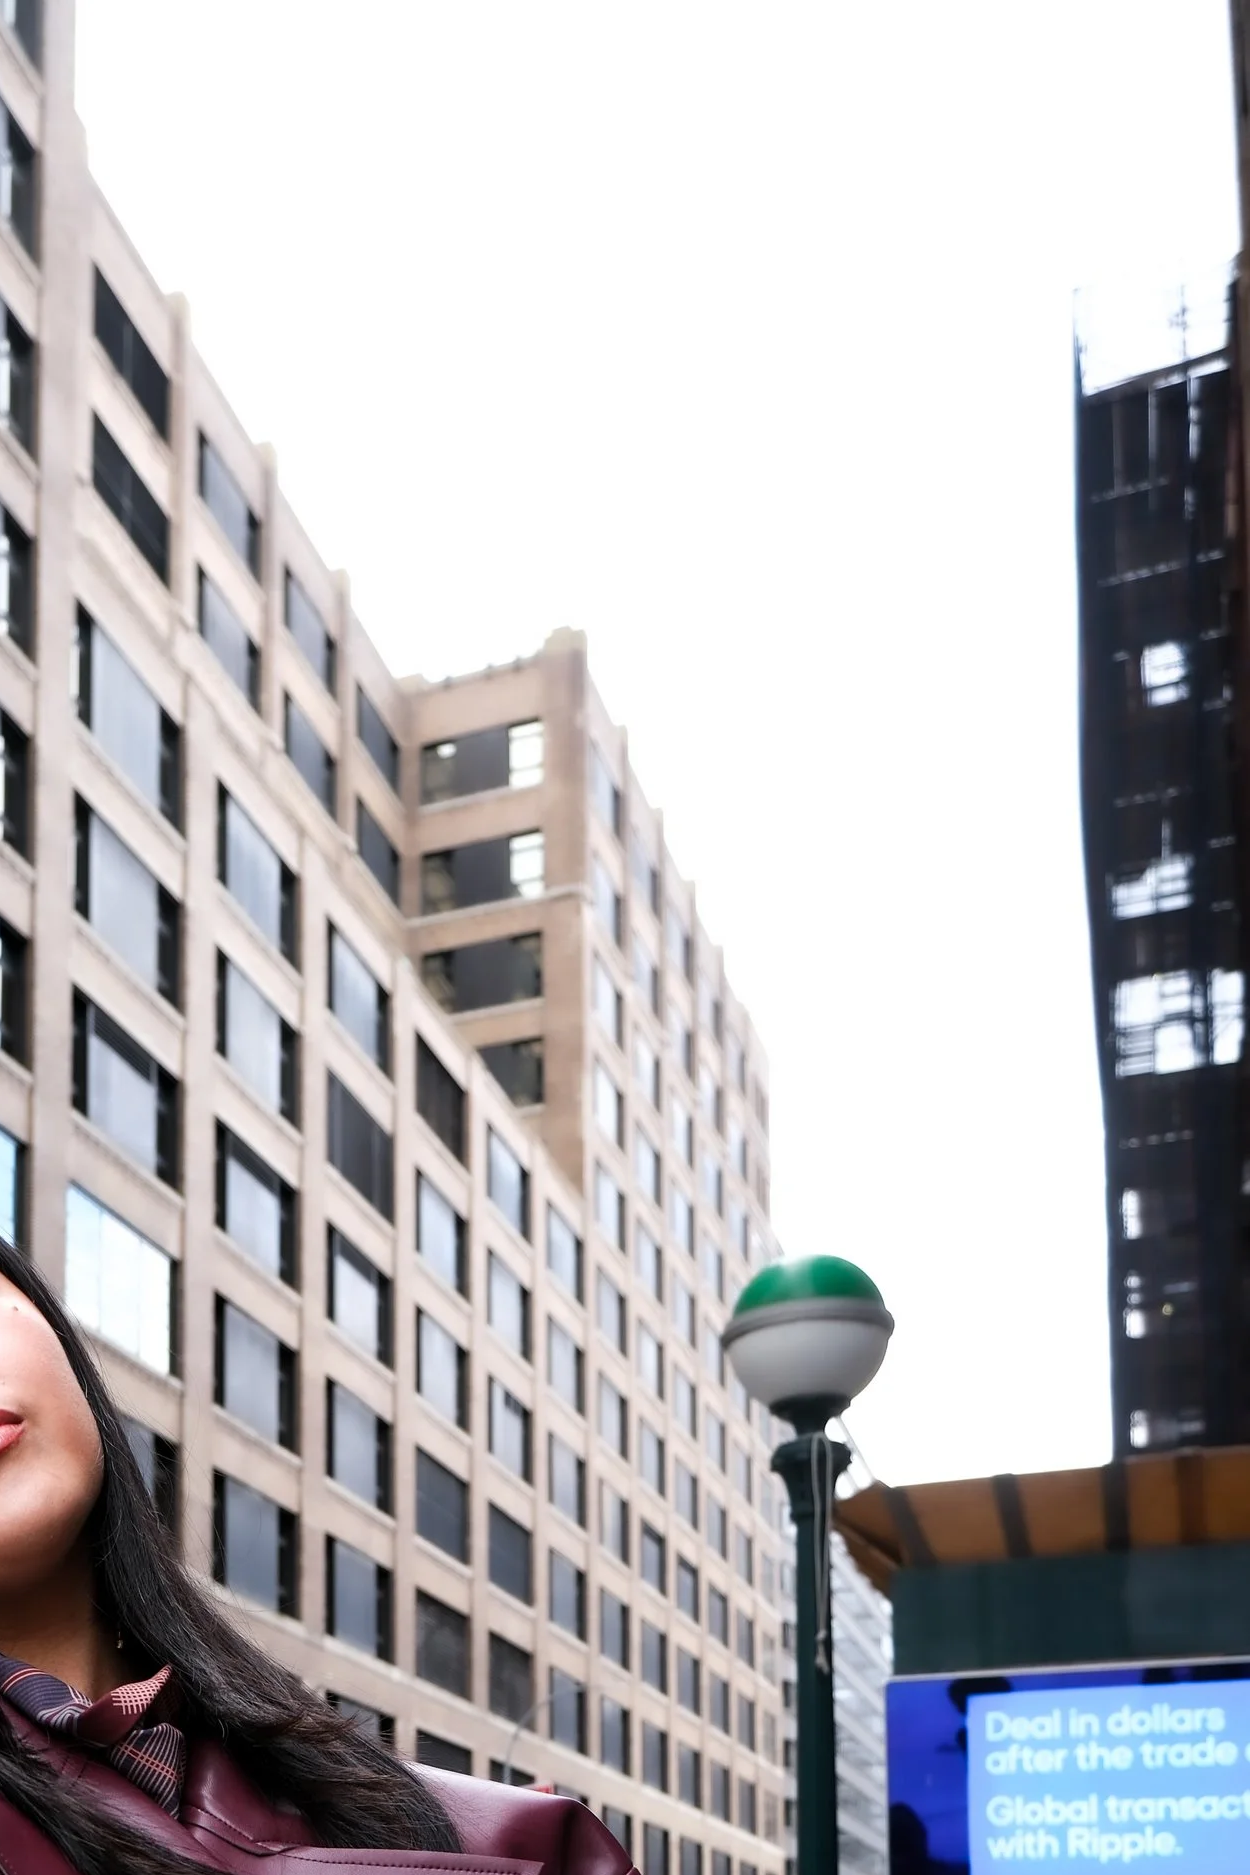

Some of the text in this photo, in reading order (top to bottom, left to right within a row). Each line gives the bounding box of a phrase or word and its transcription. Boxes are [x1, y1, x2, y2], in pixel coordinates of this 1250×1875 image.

[985, 1703, 1225, 1741] Deal in dollars
[985, 1743, 1068, 1775] after
[1074, 1740, 1134, 1771] the
[1139, 1734, 1238, 1770] trade
[986, 1793, 1098, 1826] Global
[987, 1824, 1184, 1863] with Ripple.
